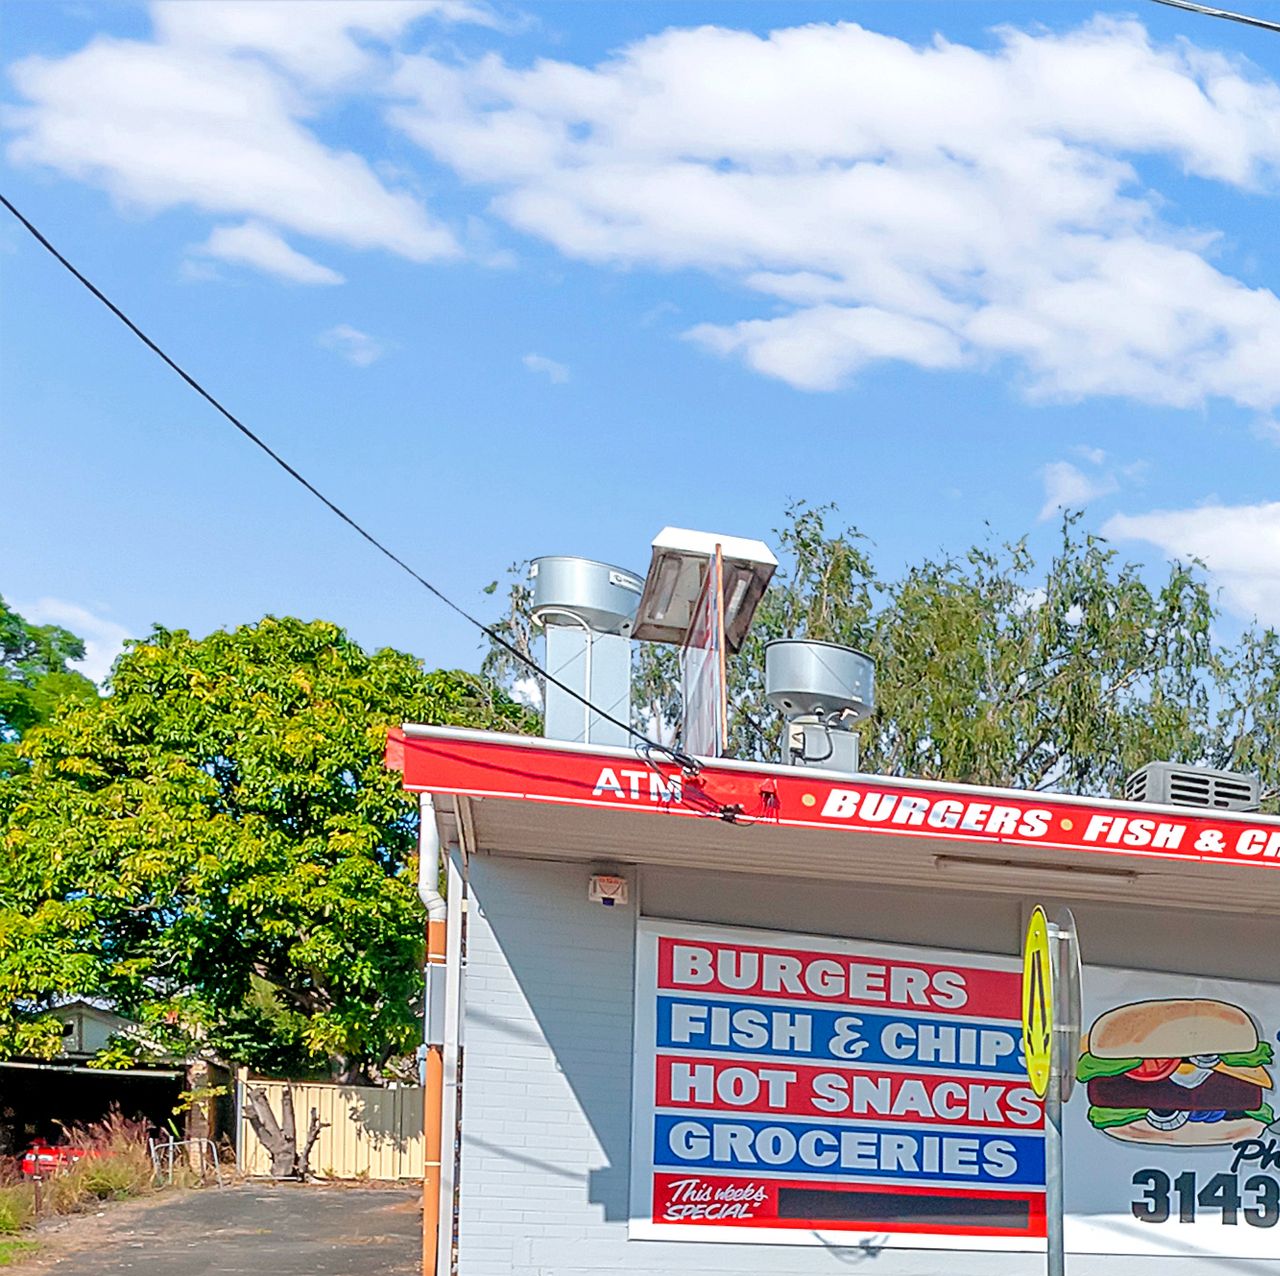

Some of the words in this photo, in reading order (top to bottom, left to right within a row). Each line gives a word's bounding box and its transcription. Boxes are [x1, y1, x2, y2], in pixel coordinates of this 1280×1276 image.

[592, 767, 683, 803] ATM
[821, 788, 1052, 838] BURGERS
[1083, 814, 1187, 850] FISH
[1194, 828, 1227, 854] &
[671, 944, 969, 1009] BURGERS
[671, 1002, 812, 1053] FISH
[828, 1016, 869, 1059] &
[670, 1062, 797, 1108] HOT
[810, 1073, 1043, 1125] SNACKS
[668, 1121, 1018, 1178] GROCERIES
[667, 1179, 712, 1201] This
[715, 1182, 769, 1202] weeks
[1131, 1169, 1280, 1228] 3143
